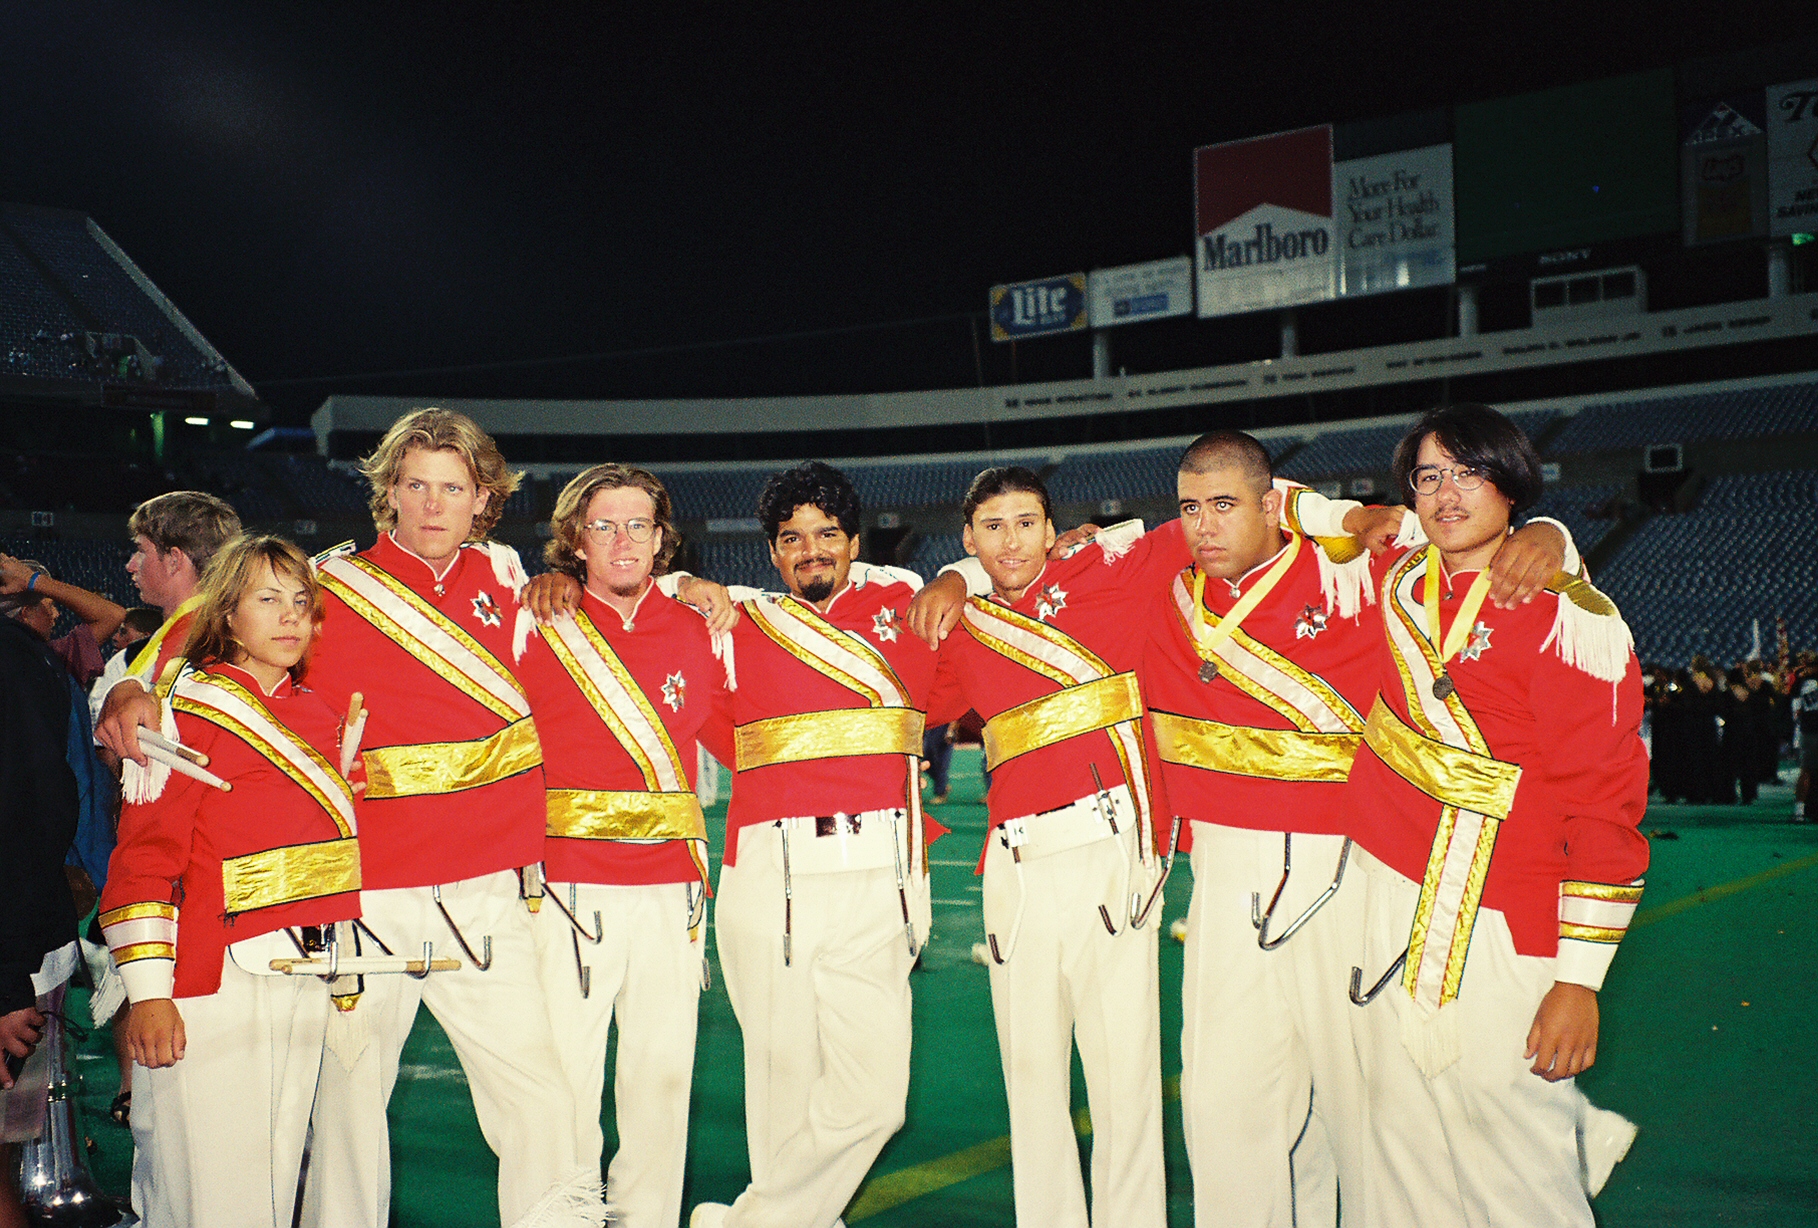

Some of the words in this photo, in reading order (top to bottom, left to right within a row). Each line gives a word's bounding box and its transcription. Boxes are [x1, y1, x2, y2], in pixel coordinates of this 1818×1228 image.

[1348, 176, 1389, 199] More
[1390, 169, 1420, 191] For
[1348, 200, 1382, 223] Your
[1387, 190, 1440, 217] Health
[1204, 223, 1329, 271] Marlboro
[1348, 226, 1386, 249] Care
[1387, 216, 1438, 244] Dollar
[1538, 247, 1591, 265] SONY
[1013, 287, 1067, 326] Lite
